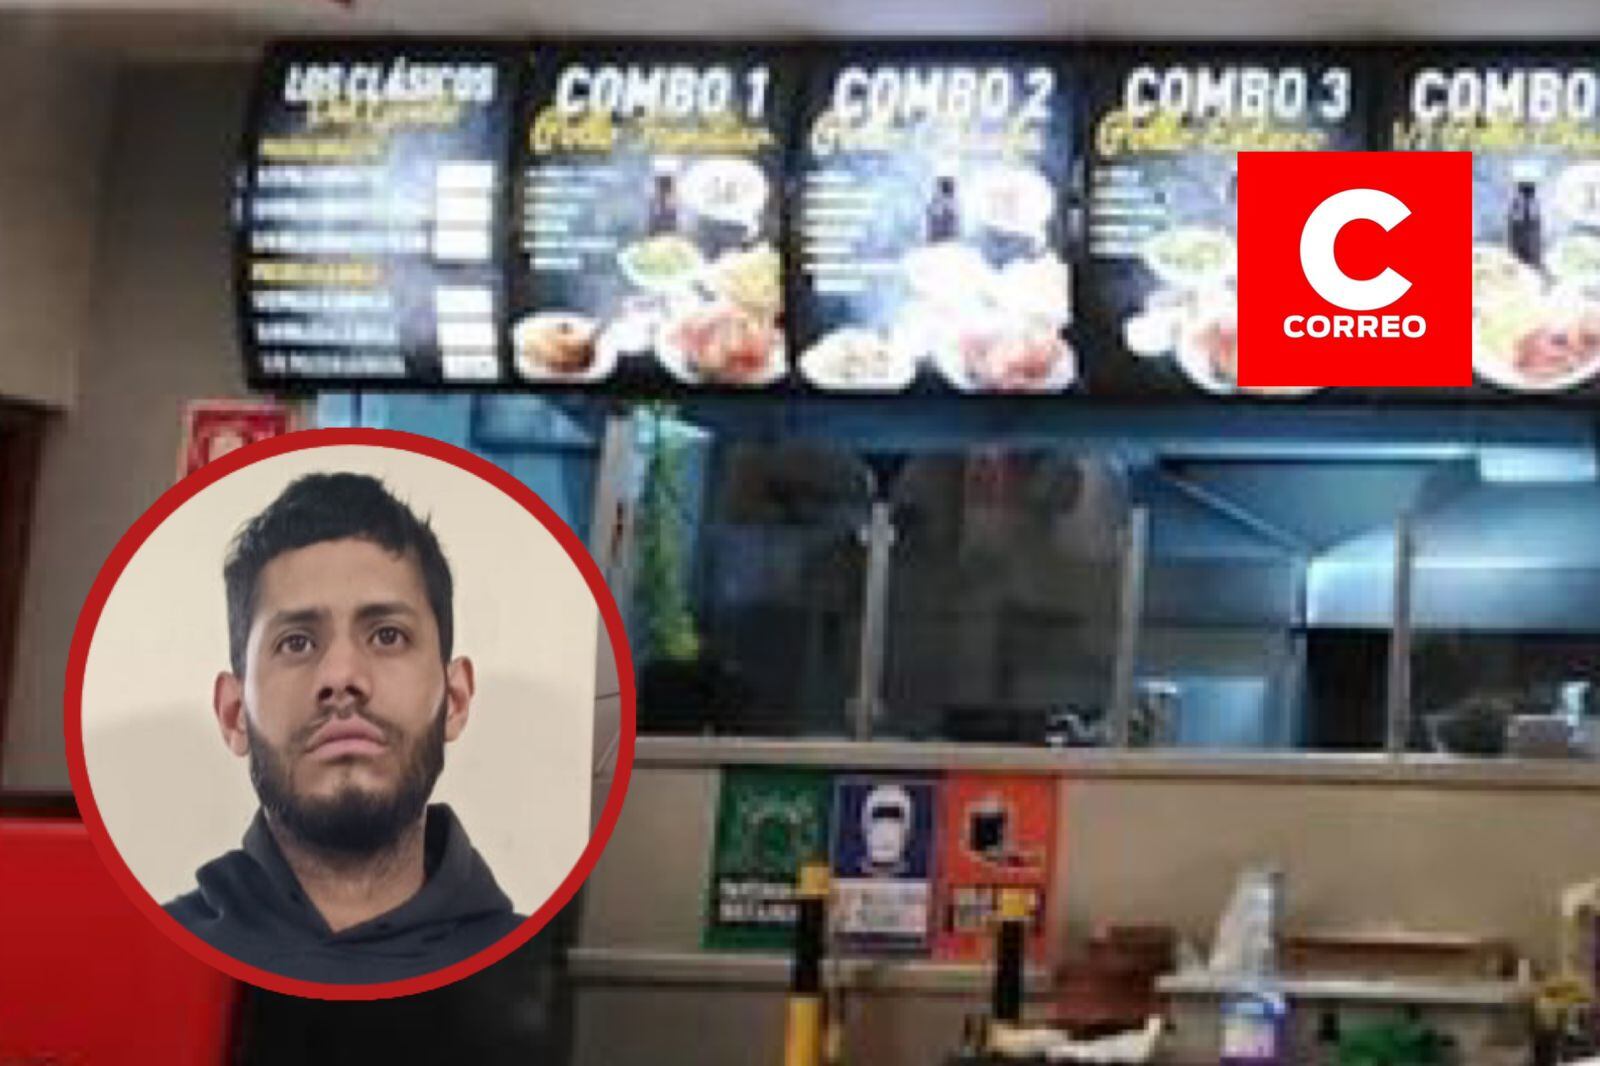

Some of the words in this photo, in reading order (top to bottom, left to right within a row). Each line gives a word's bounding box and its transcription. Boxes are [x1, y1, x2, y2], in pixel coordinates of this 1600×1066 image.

[284, 62, 344, 101] LOS
[555, 63, 734, 116] COMBO
[746, 64, 769, 118] 1
[834, 65, 1009, 119] COMBO
[1021, 66, 1056, 120] 2
[1124, 66, 1307, 119] COMBO
[1321, 67, 1350, 121] 3
[1411, 68, 1597, 119] COMBO
